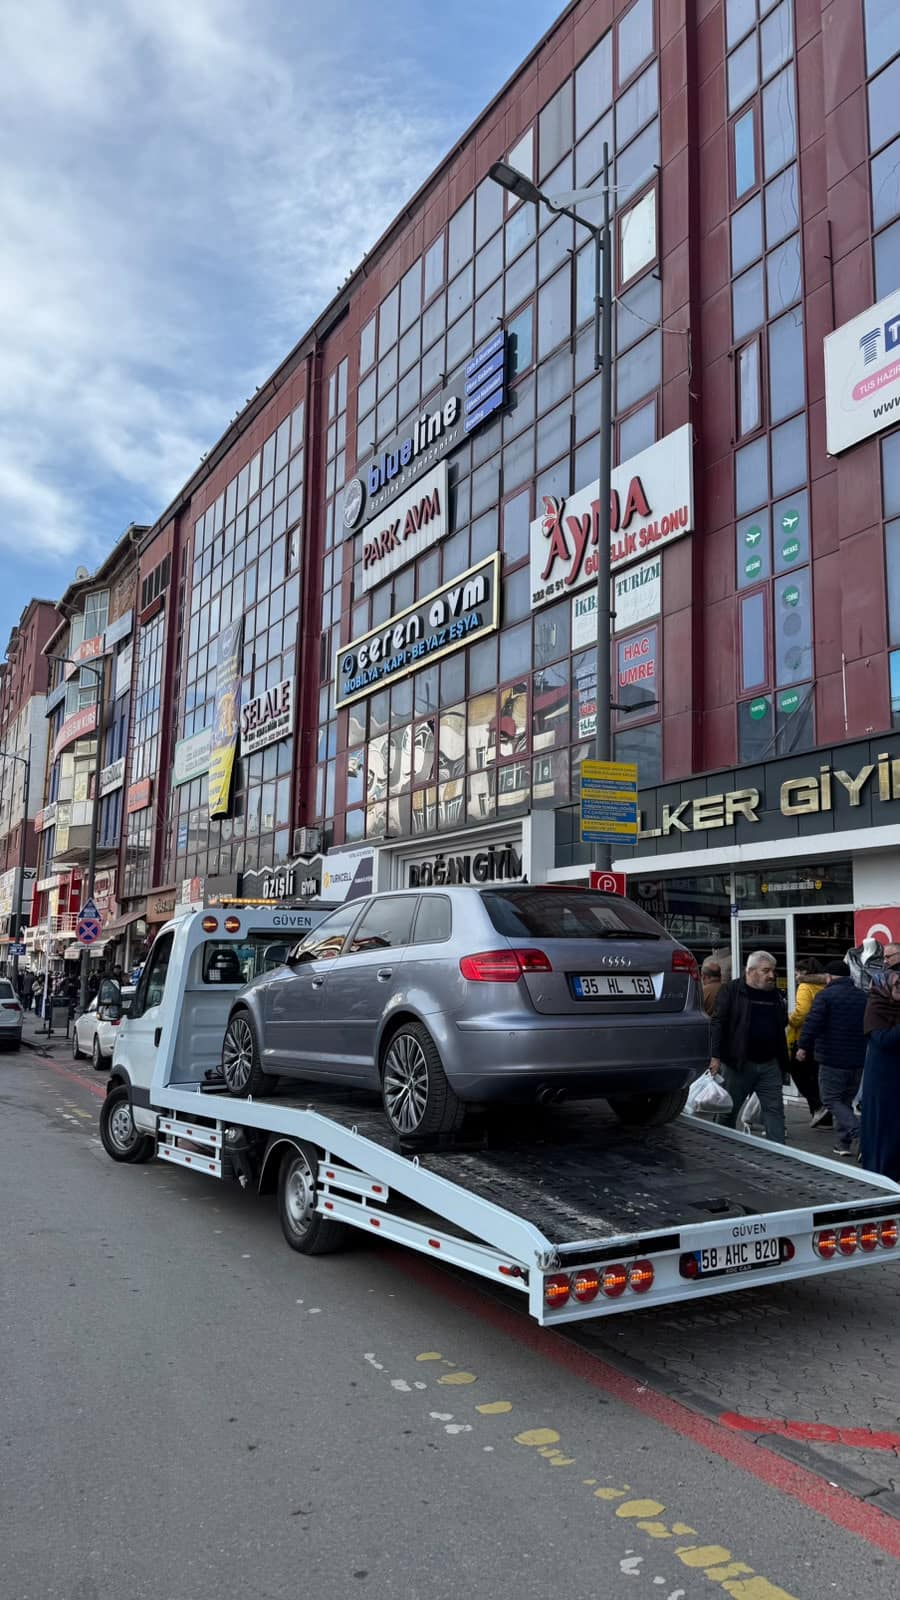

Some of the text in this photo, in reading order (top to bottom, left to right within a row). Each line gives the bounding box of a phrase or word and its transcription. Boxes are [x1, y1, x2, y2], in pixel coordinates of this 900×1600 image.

[859, 382, 876, 396] TUS
[368, 396, 458, 497] blueline
[362, 487, 441, 570] PARK AVM
[584, 505, 689, 576] GÜLLİK SALONU
[616, 561, 660, 596] TURİZM
[357, 575, 486, 669] ceren avm
[412, 630, 447, 661] BEYAZ
[450, 612, 479, 640] EŞYA
[624, 638, 650, 661] HAC
[618, 661, 655, 688] UMRE
[240, 679, 291, 742] ŞELALE
[637, 787, 760, 840] LKER
[272, 913, 312, 926] GÜVEN
[582, 977, 652, 994] 35 HL 163
[732, 1222, 768, 1238] GÜVEN
[701, 1238, 778, 1269] 58 AHC 820
